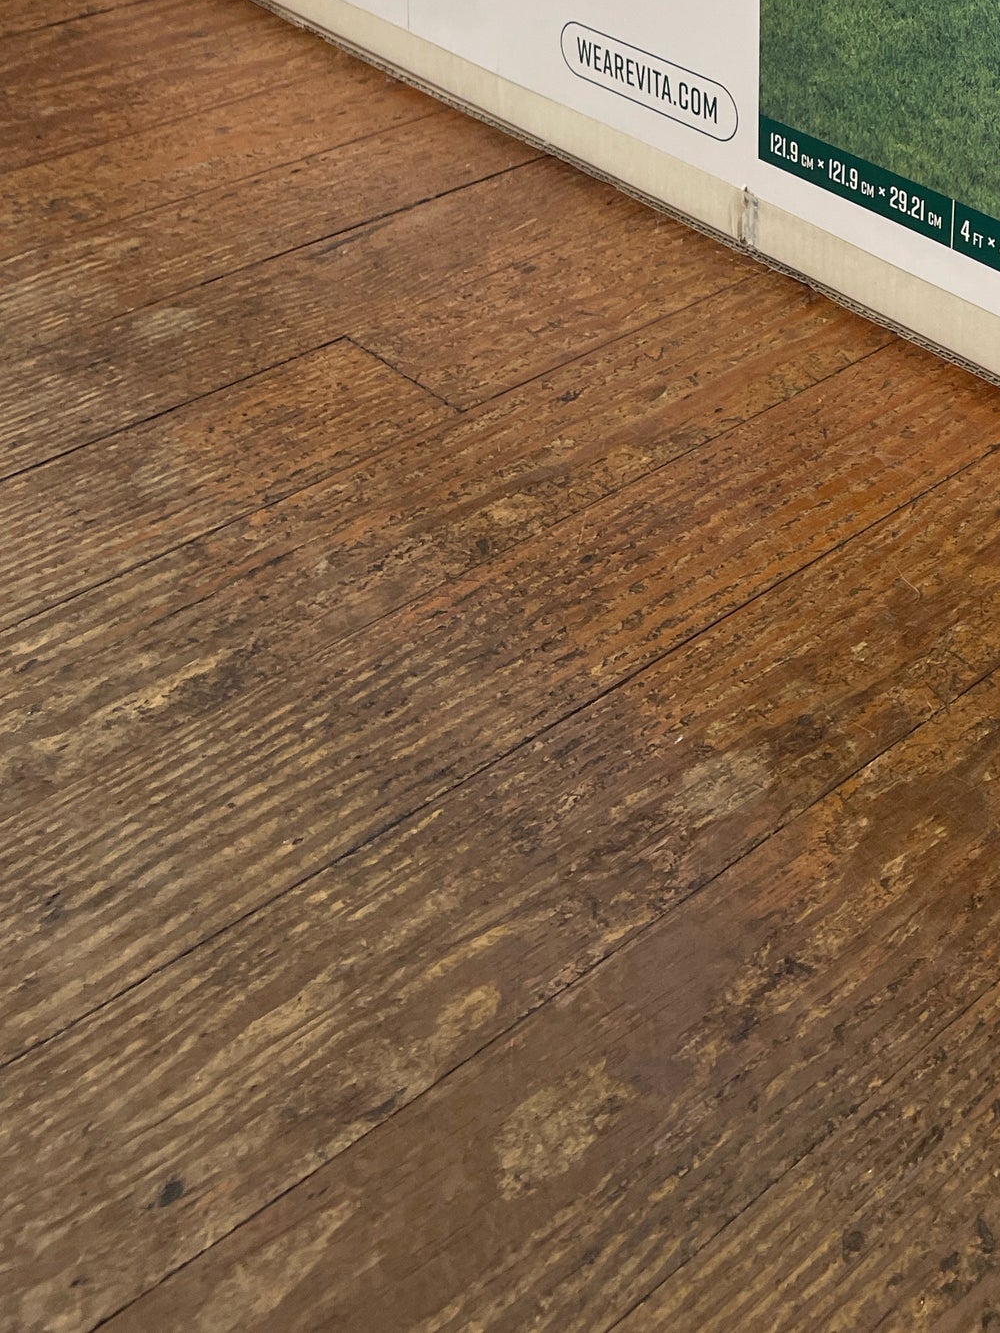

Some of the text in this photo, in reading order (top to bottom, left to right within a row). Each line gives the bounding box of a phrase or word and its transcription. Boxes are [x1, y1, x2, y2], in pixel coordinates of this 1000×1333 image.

[577, 36, 718, 124] WEAREVITA.COM
[770, 132, 798, 163] 121.9
[801, 153, 814, 170] CM
[828, 158, 858, 190] 121.9
[861, 180, 874, 198] CM
[889, 186, 925, 221] 29.21
[928, 211, 942, 230] CM
[960, 219, 970, 243] 4
[972, 232, 984, 248] FT
